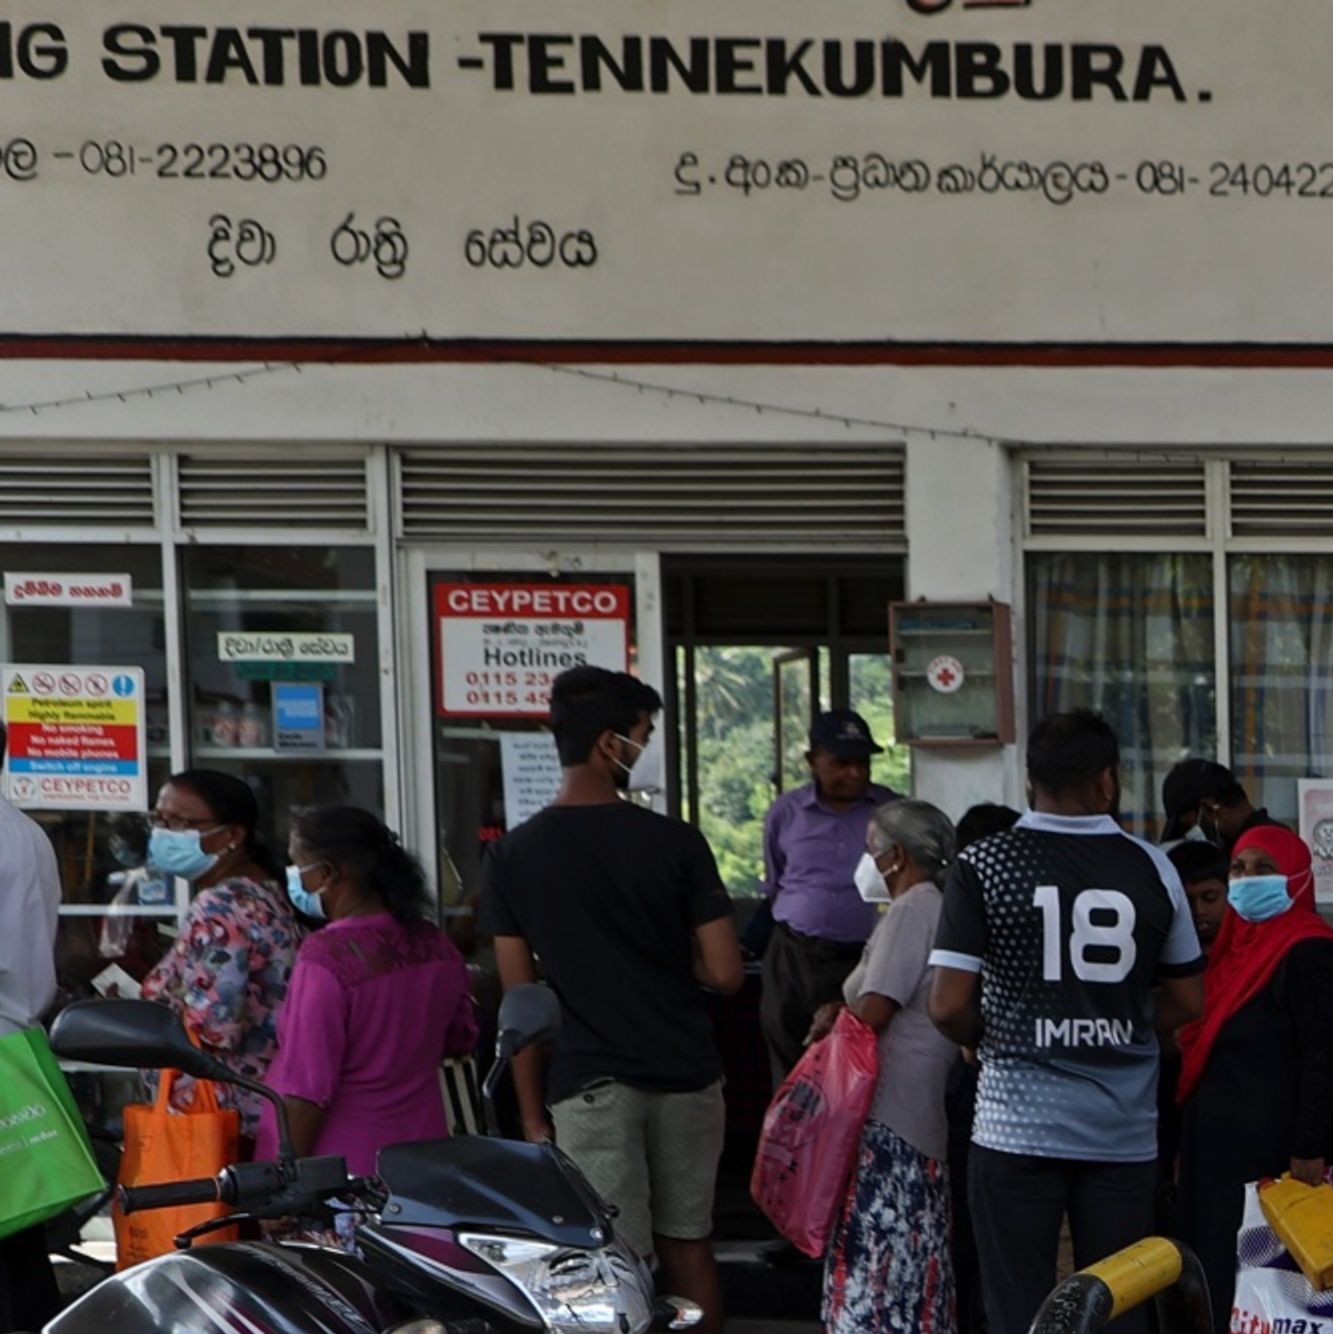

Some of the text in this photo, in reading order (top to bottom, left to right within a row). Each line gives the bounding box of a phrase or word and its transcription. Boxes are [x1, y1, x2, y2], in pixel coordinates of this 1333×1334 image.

[102, 24, 430, 88] STATION
[463, 215, 599, 270] සේවය
[447, 588, 619, 614] CEYPETCO
[484, 647, 588, 668] Hotlines
[465, 671, 557, 686] 0115 23
[466, 691, 555, 705] 0115 45
[41, 779, 132, 794] CEYPETCO
[1032, 885, 1137, 983] 18
[1034, 1017, 1135, 1049] IMRAN
